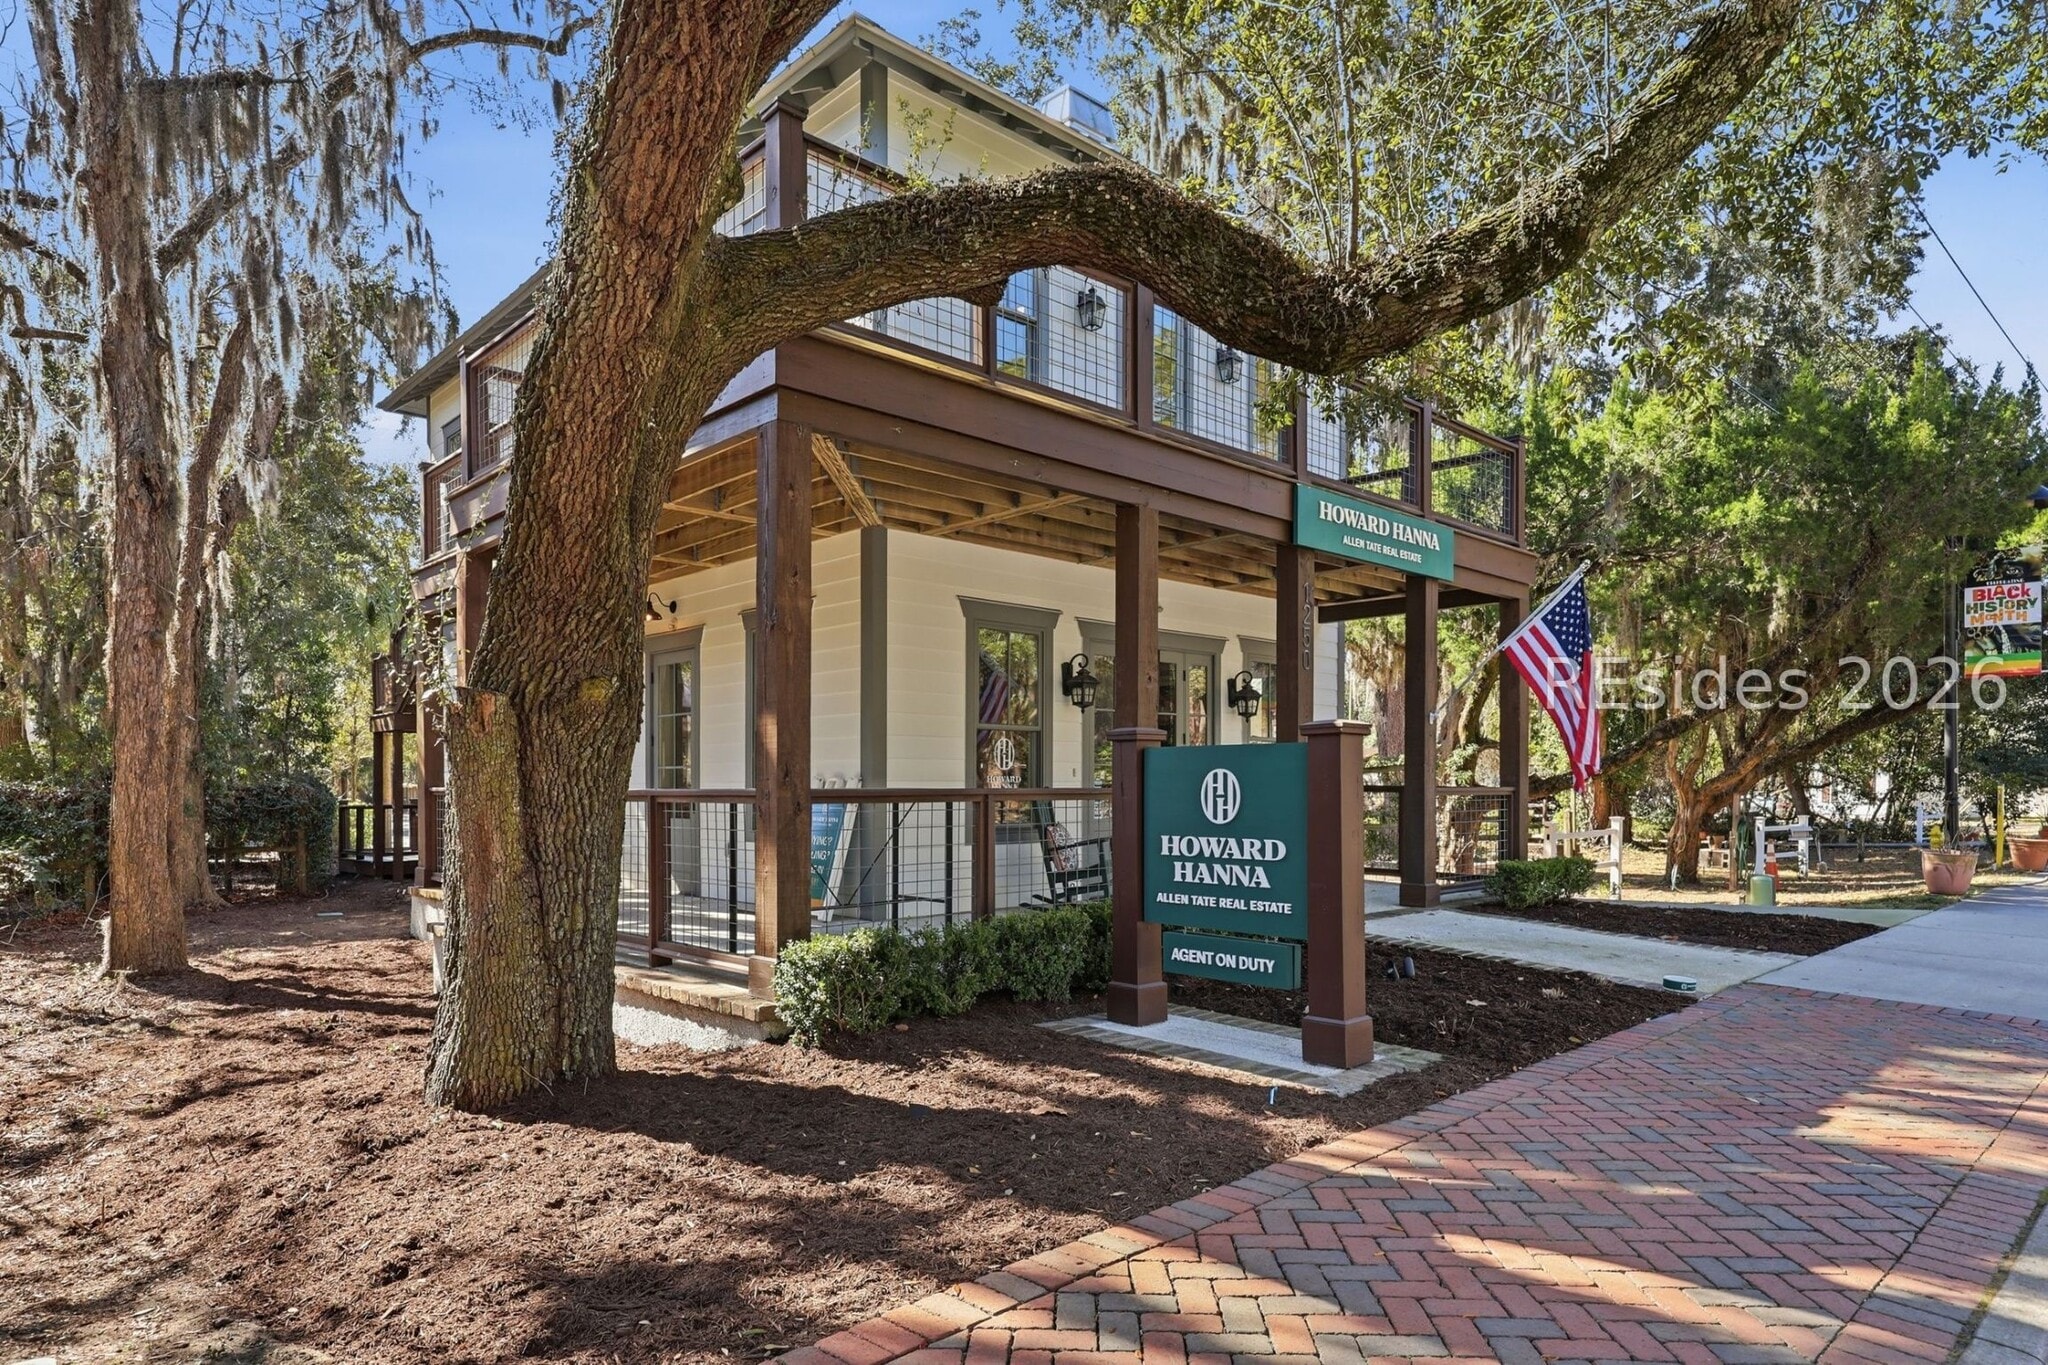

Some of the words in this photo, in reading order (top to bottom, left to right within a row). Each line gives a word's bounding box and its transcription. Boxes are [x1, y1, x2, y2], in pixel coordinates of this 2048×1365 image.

[1319, 501, 1389, 536] HOWARD
[1392, 522, 1440, 551] HANNA
[1342, 535, 1364, 548] ALLEN
[1366, 541, 1382, 553] TATE
[1383, 545, 1399, 558] REAL
[1400, 549, 1422, 564] ESTATE
[1966, 596, 2038, 615] HISTORY
[1969, 608, 2028, 625] MONTH
[986, 775, 1022, 783] HOWARD
[1160, 835, 1287, 861] HOWARD
[1173, 861, 1271, 889] HANNA
[1156, 892, 1189, 905] ALLEN
[1191, 895, 1217, 908] TATE
[1219, 898, 1247, 910] REAL
[1249, 901, 1292, 914] ESTATE
[1171, 947, 1214, 965] AGENT
[1215, 953, 1236, 970] ON
[1238, 956, 1275, 974] DUTY
